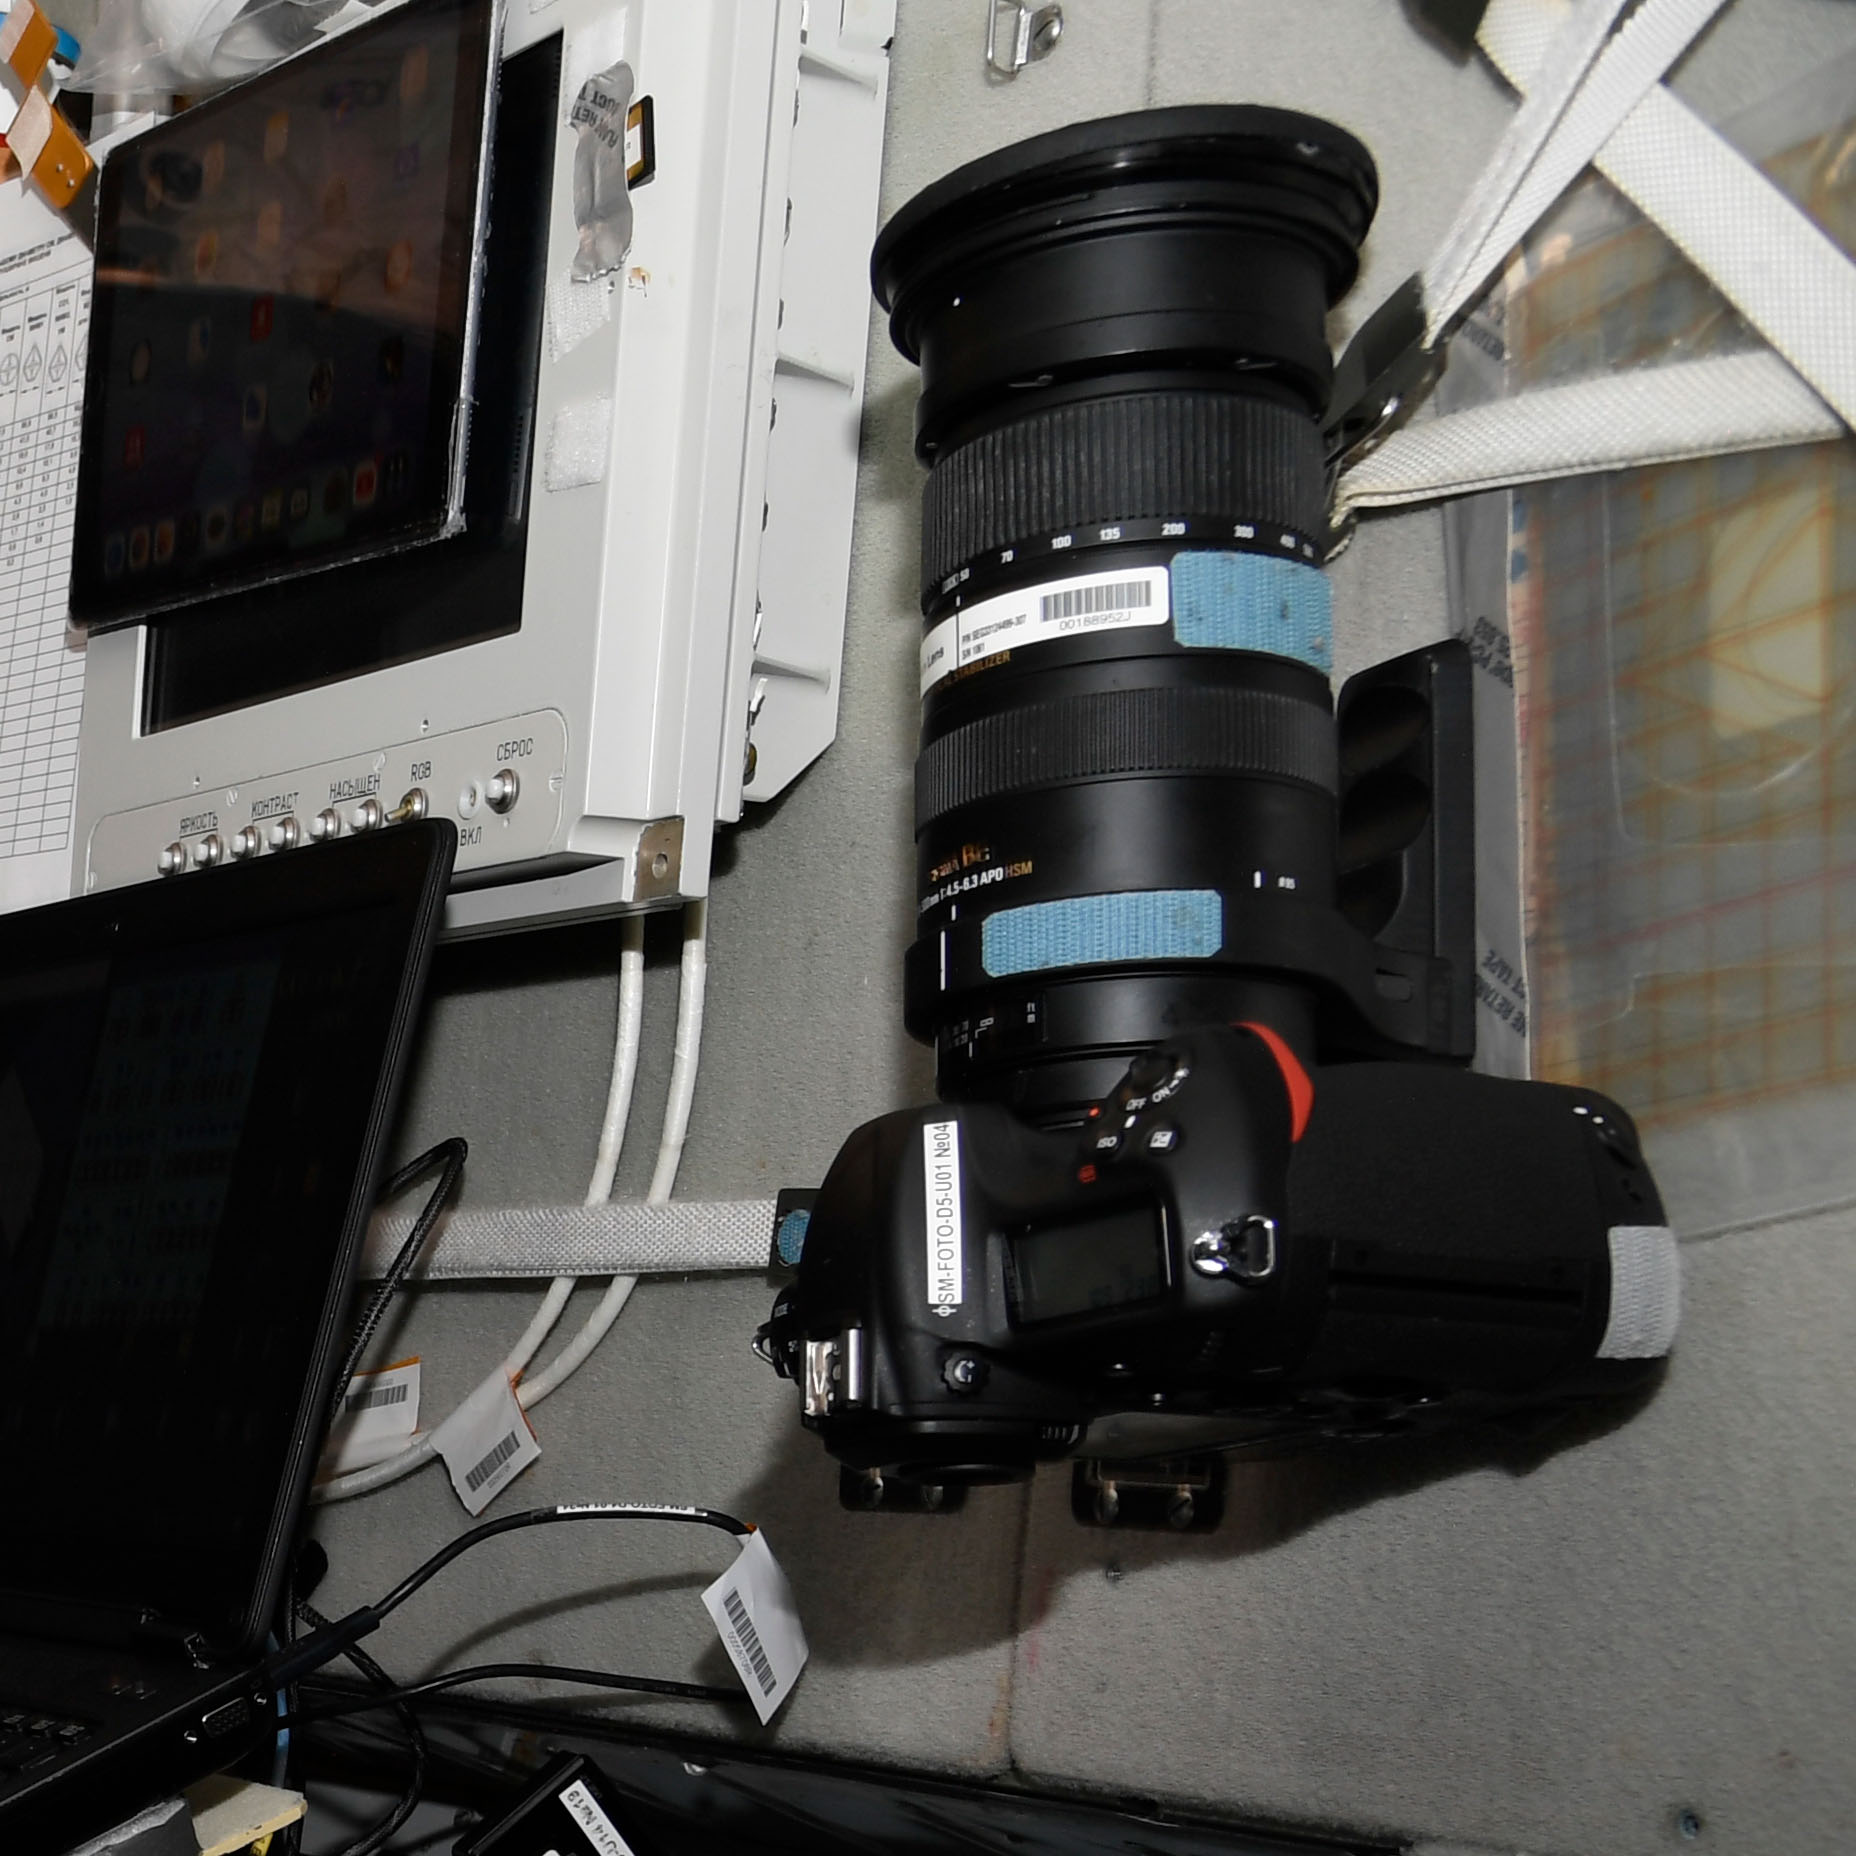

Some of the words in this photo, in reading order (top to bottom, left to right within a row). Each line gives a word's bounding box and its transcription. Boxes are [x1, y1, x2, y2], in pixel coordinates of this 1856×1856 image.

[1099, 526, 1121, 541] 135
[1161, 522, 1186, 536] 200
[1051, 534, 1072, 550] 100
[999, 550, 1014, 564] 70
[1059, 611, 1132, 631] 00188952J
[495, 737, 534, 763] СБРОС
[409, 761, 432, 783] RGB
[328, 774, 382, 801] НАСЫЩЕН
[250, 792, 300, 818] КОНТРАСТ
[179, 811, 220, 834] ЯРКОСТЬ
[459, 828, 483, 848] ВКЛ
[979, 866, 1004, 886] APO
[1005, 860, 1033, 878] HSM
[1126, 1097, 1146, 1111] OFF
[1152, 1087, 1171, 1103] ON
[932, 1123, 952, 1158] №04
[1096, 1135, 1118, 1149] ISO
[934, 1162, 956, 1304] SM-FOTO-D5-U01
